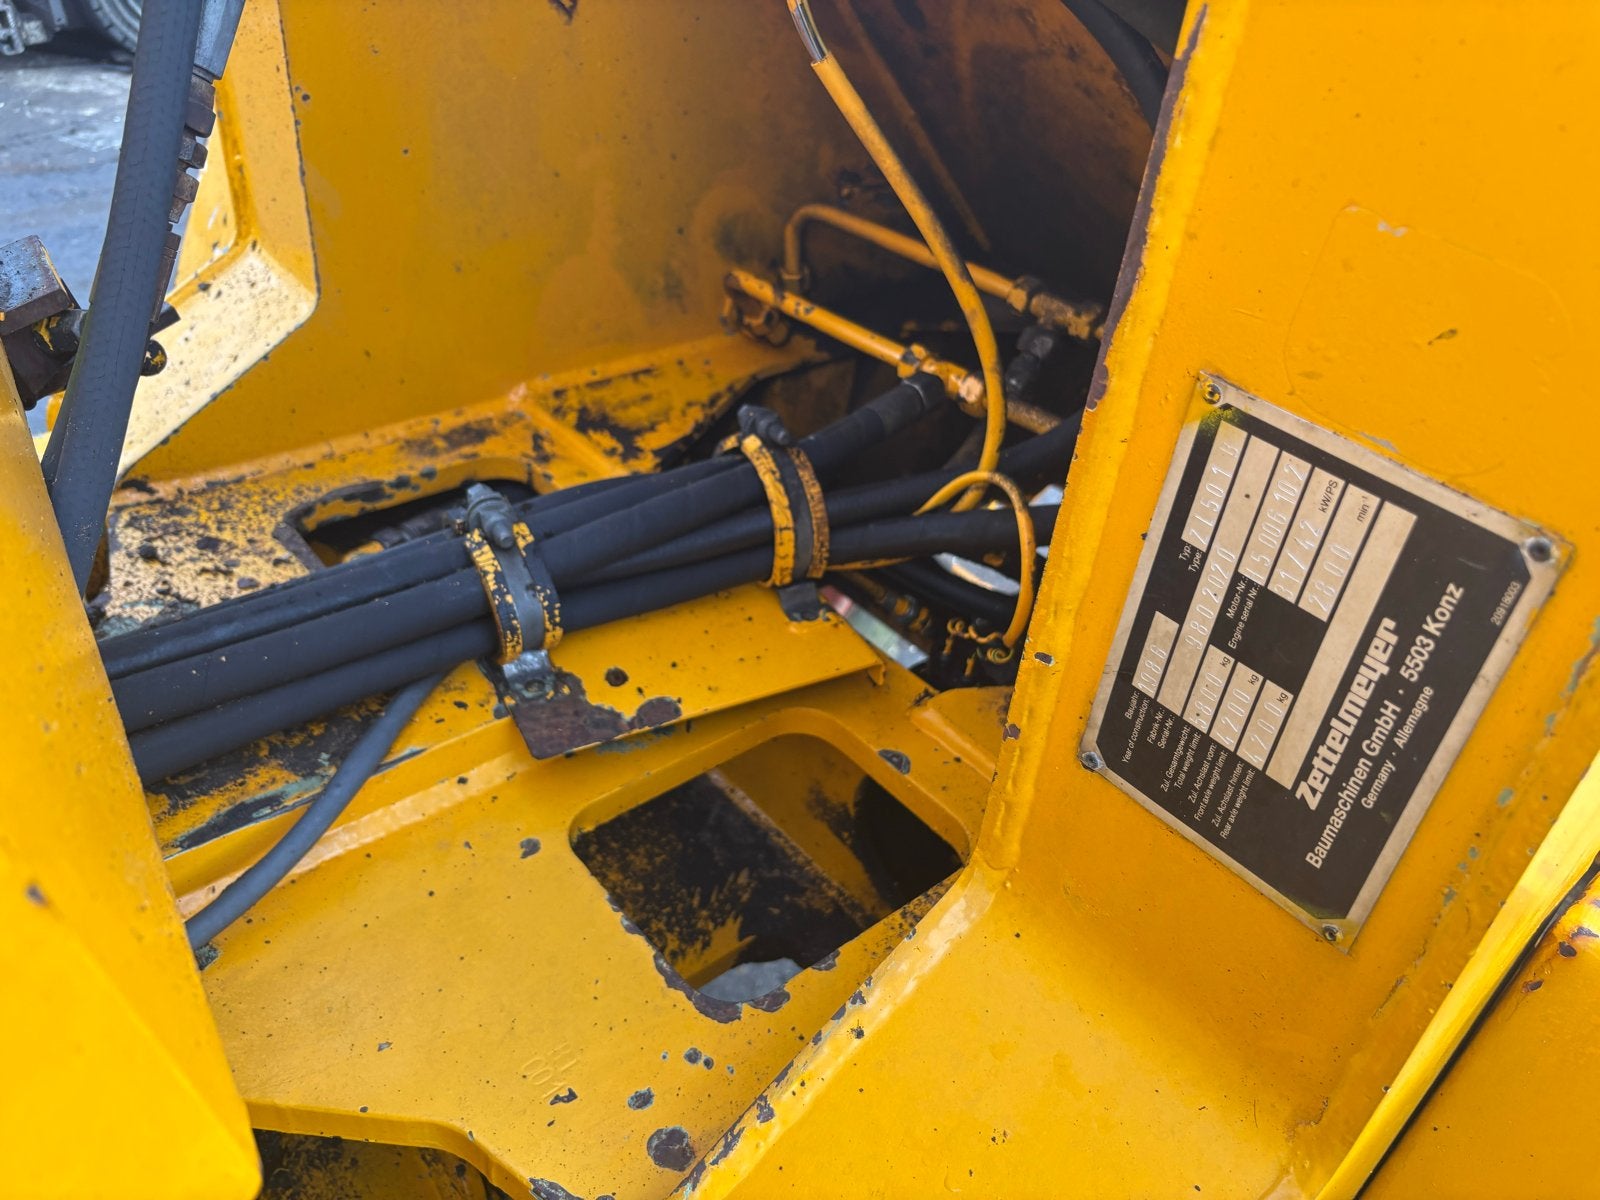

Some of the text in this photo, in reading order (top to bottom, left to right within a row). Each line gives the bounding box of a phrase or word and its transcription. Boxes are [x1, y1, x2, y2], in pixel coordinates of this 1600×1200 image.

[1317, 478, 1339, 514] kW/PS
[1178, 541, 1192, 562] Typ:
[1188, 548, 1204, 574] Type:
[1227, 616, 1248, 650] Engine
[1239, 597, 1253, 619] serial
[1489, 578, 1522, 626] 20918003
[1218, 654, 1231, 669] kg
[1124, 689, 1141, 720] Baujahr:
[1214, 672, 1259, 746] 4200 kg
[1276, 690, 1288, 704] kg
[1294, 617, 1399, 811] Zettelmeyer
[1305, 579, 1464, 869] Baumaschinen GmbH 5503 Konz
[1121, 696, 1150, 764] Year of construction:
[1160, 723, 1192, 792] Zul. Gesamtgewicht:
[1359, 683, 1436, 812] Germany Allemagne
[1174, 730, 1202, 789] Total weight limit:
[1192, 759, 1210, 790] Achslast
[1193, 748, 1228, 821] Front axle weight limit:
[1187, 788, 1198, 803] Zul.
[1211, 759, 1244, 827] Zul. Achslast hinten:
[1219, 766, 1256, 839] Rear axle weight limit:
